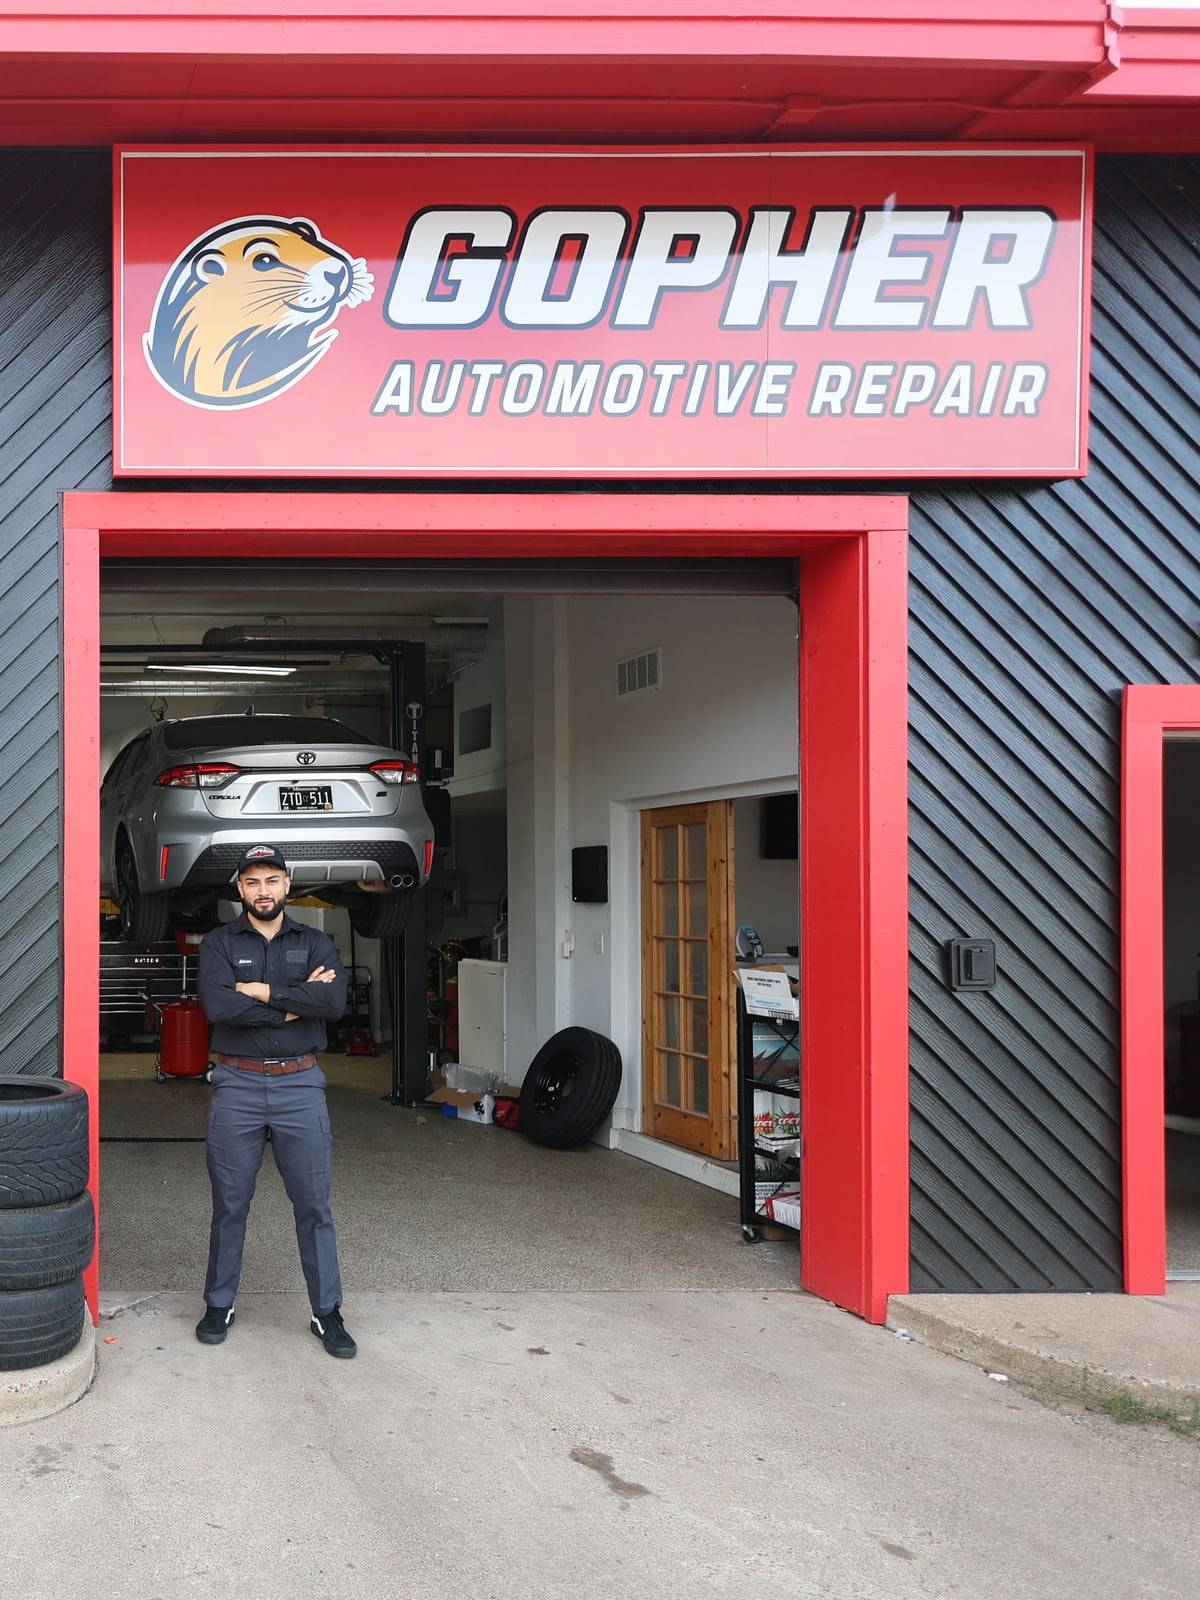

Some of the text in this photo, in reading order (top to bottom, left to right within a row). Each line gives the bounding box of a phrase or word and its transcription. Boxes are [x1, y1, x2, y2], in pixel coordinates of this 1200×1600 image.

[383, 205, 1056, 330] GOPHER
[370, 359, 1051, 418] AUTOMOTIVE REPAIR
[309, 791, 329, 806] 511
